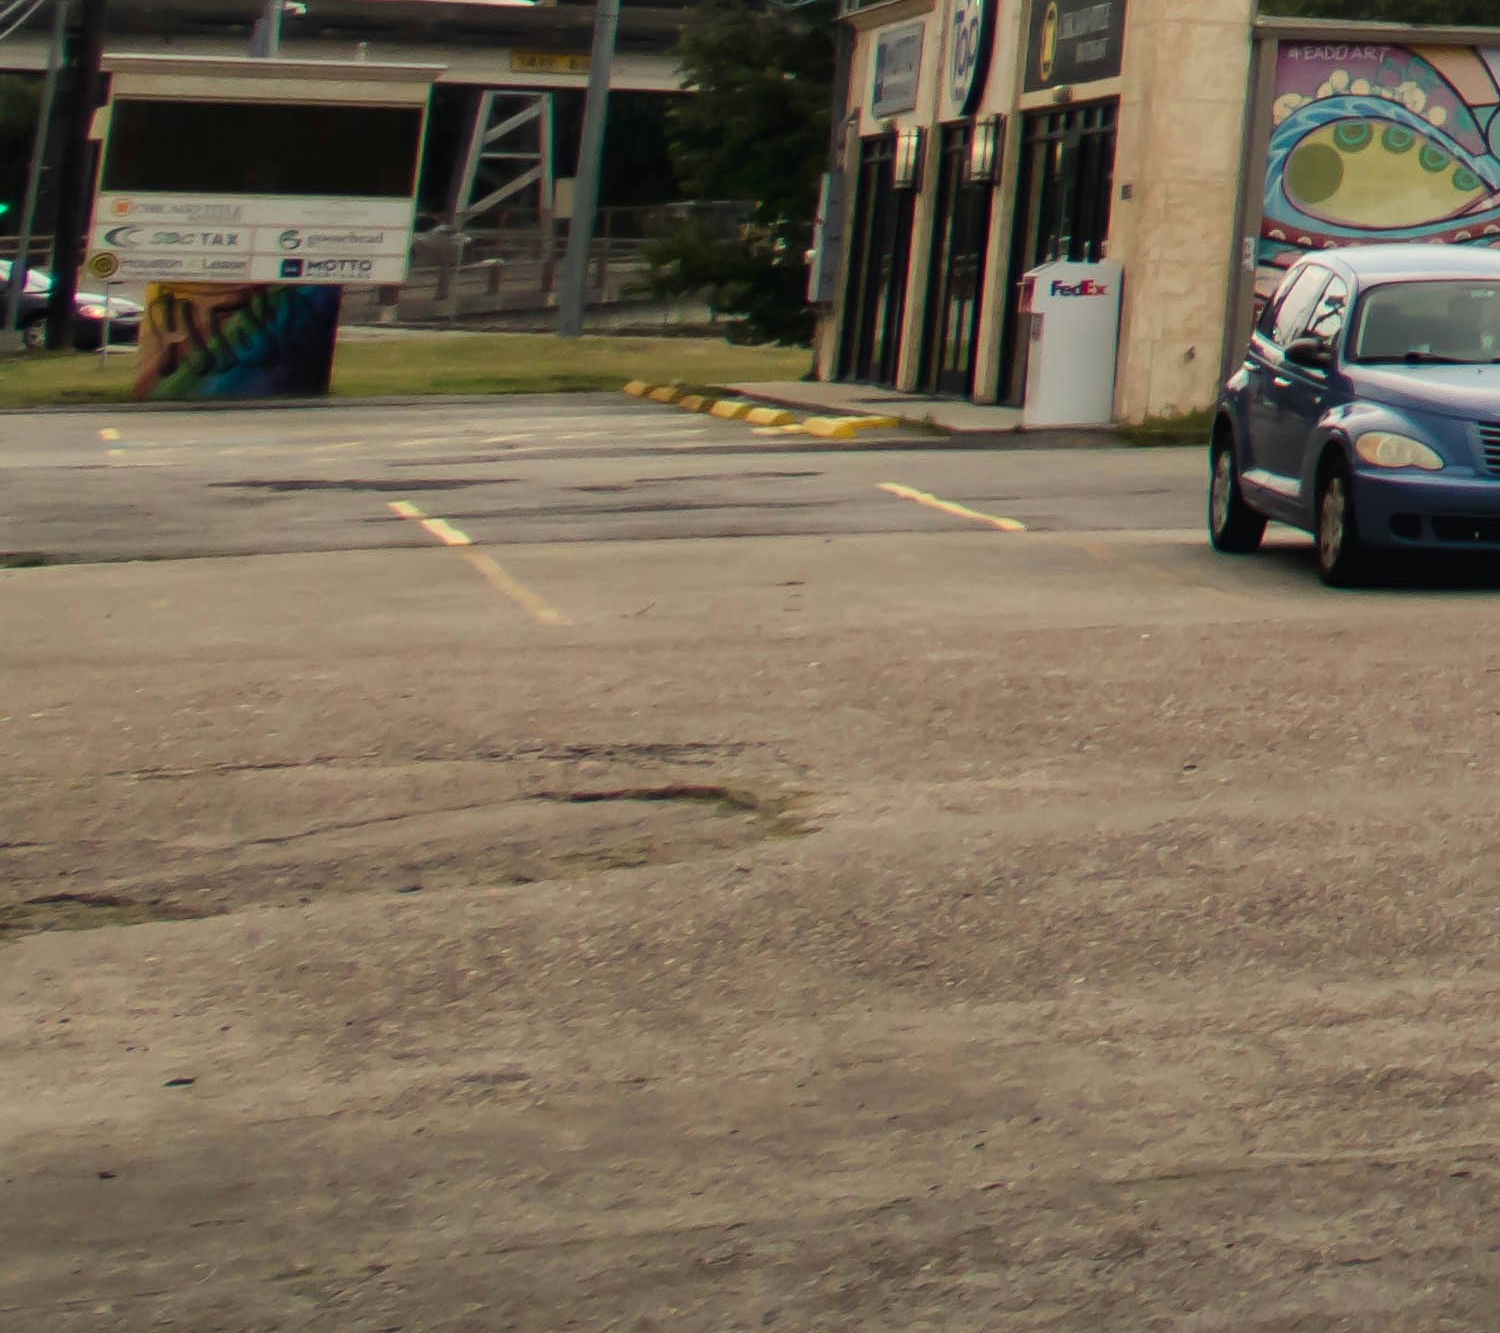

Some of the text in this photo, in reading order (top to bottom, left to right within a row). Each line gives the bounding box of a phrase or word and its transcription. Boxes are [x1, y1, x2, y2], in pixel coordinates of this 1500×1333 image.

[200, 232, 240, 246] TAX
[307, 258, 373, 271] MOTTO
[1050, 279, 1107, 297] FedEx
